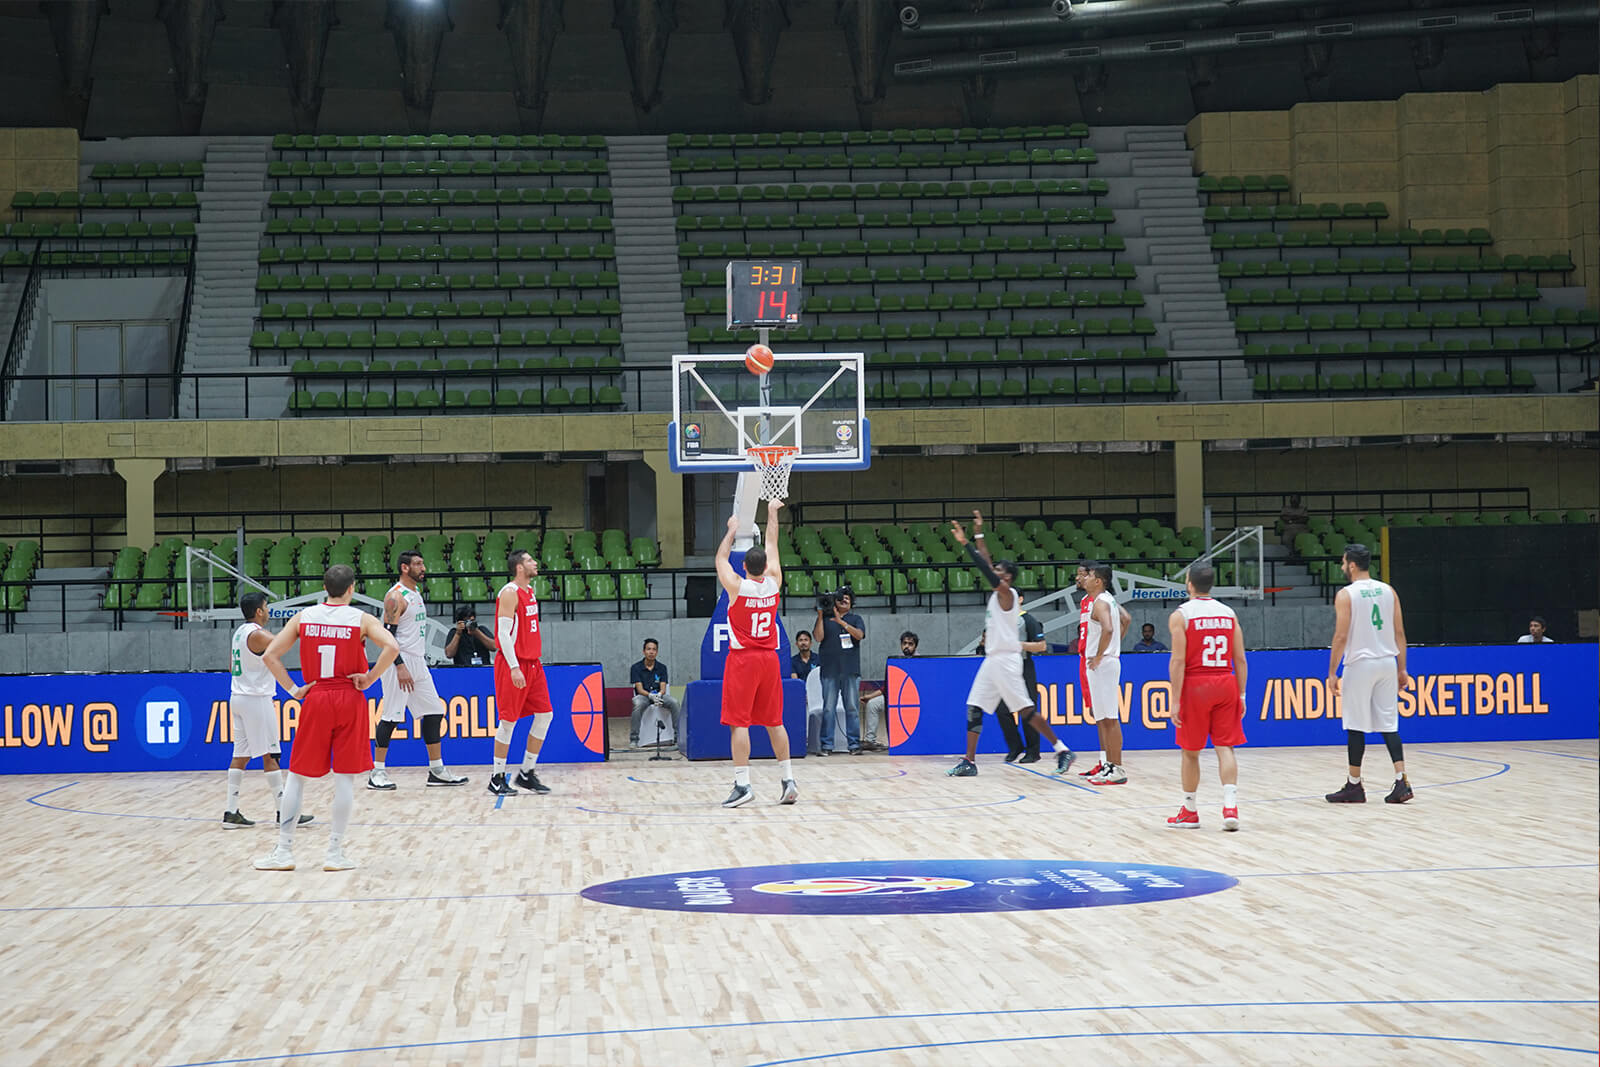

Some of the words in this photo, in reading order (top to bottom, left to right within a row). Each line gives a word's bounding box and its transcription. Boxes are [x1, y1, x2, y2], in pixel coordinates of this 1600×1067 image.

[750, 266, 796, 285] 3:31
[758, 291, 788, 319] 14
[1132, 588, 1187, 599] Hercules
[751, 612, 771, 638] 12
[1371, 603, 1383, 630] 4
[305, 624, 320, 637] ABU
[317, 645, 336, 678] 1
[1202, 635, 1228, 667] 22
[0, 703, 75, 748] LOW
